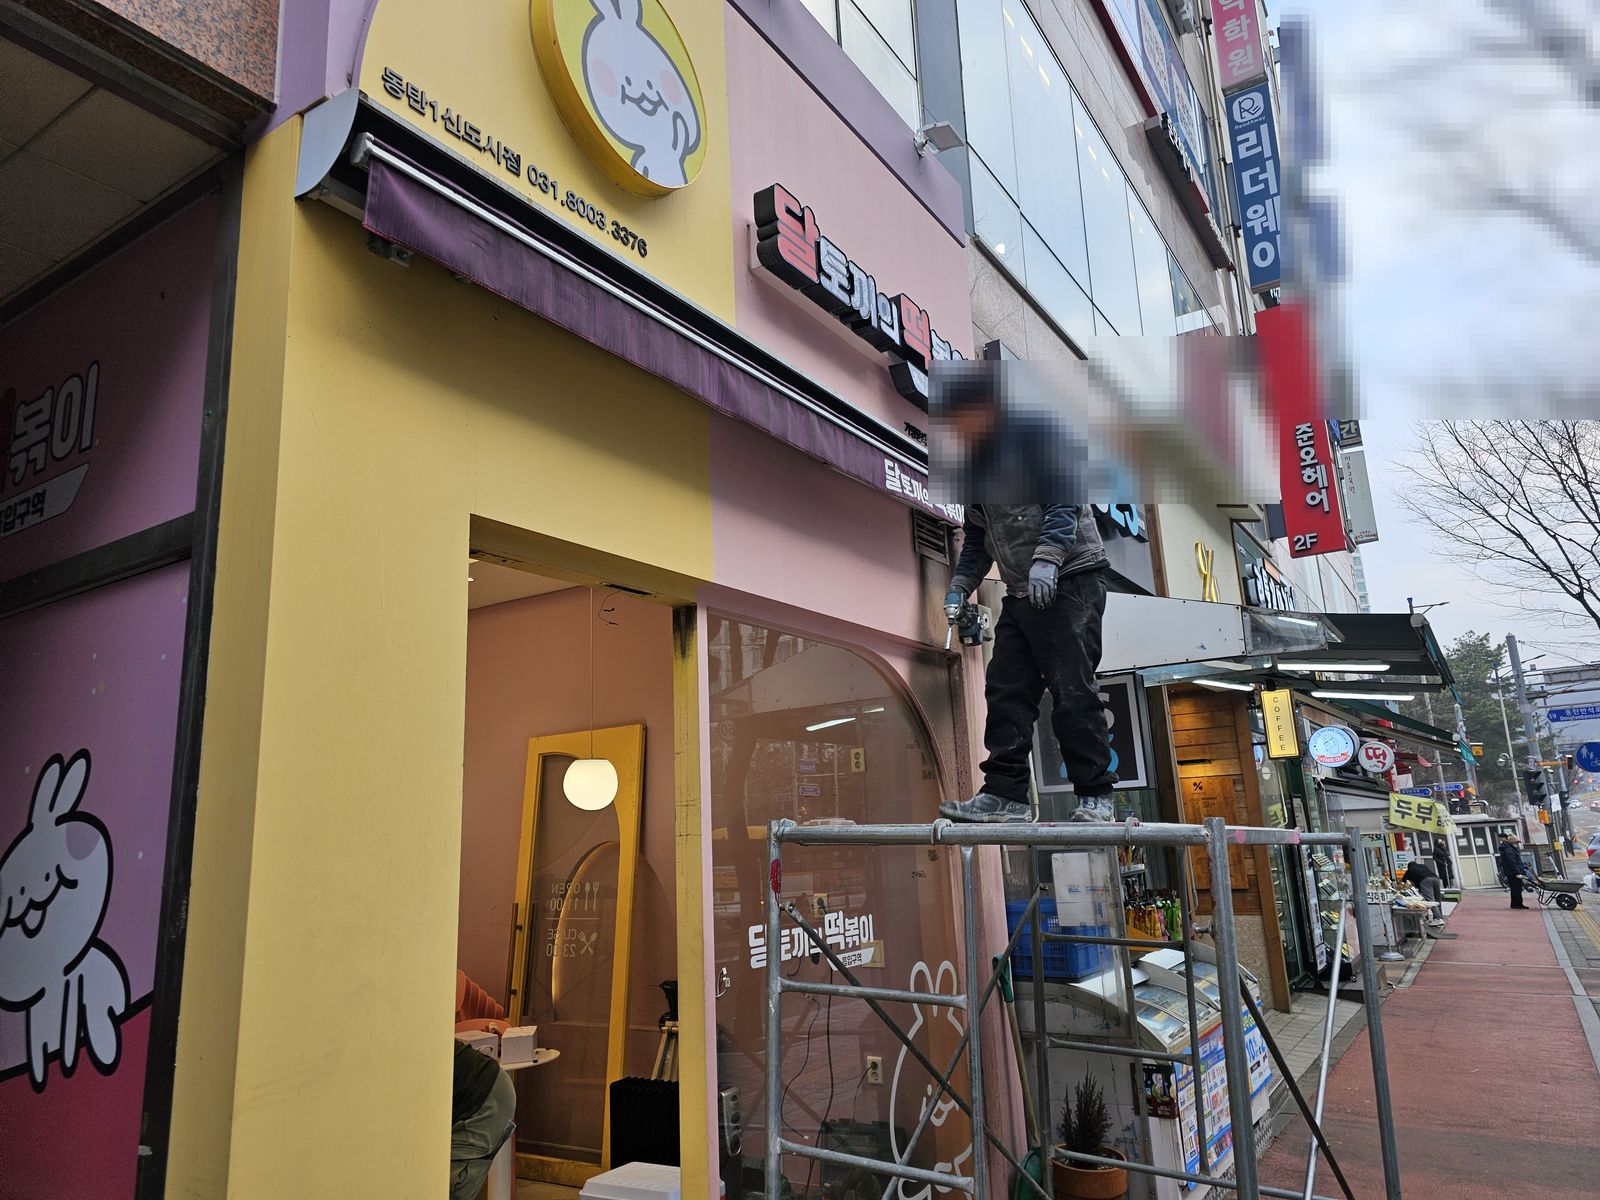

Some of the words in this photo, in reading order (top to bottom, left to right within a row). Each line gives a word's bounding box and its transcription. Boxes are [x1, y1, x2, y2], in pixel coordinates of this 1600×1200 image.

[381, 66, 521, 177] 동탄1신도시점
[527, 164, 648, 258] 031.8003.3376
[765, 183, 901, 347] 달토끼의
[1, 361, 99, 490] 볶이
[1295, 422, 1330, 513] 준오헤어
[0, 489, 47, 534] 입구역
[1293, 532, 1318, 551] 2F
[1272, 696, 1286, 751] COFFEE
[1394, 799, 1433, 825] 두부
[825, 910, 874, 950] 떡볶이
